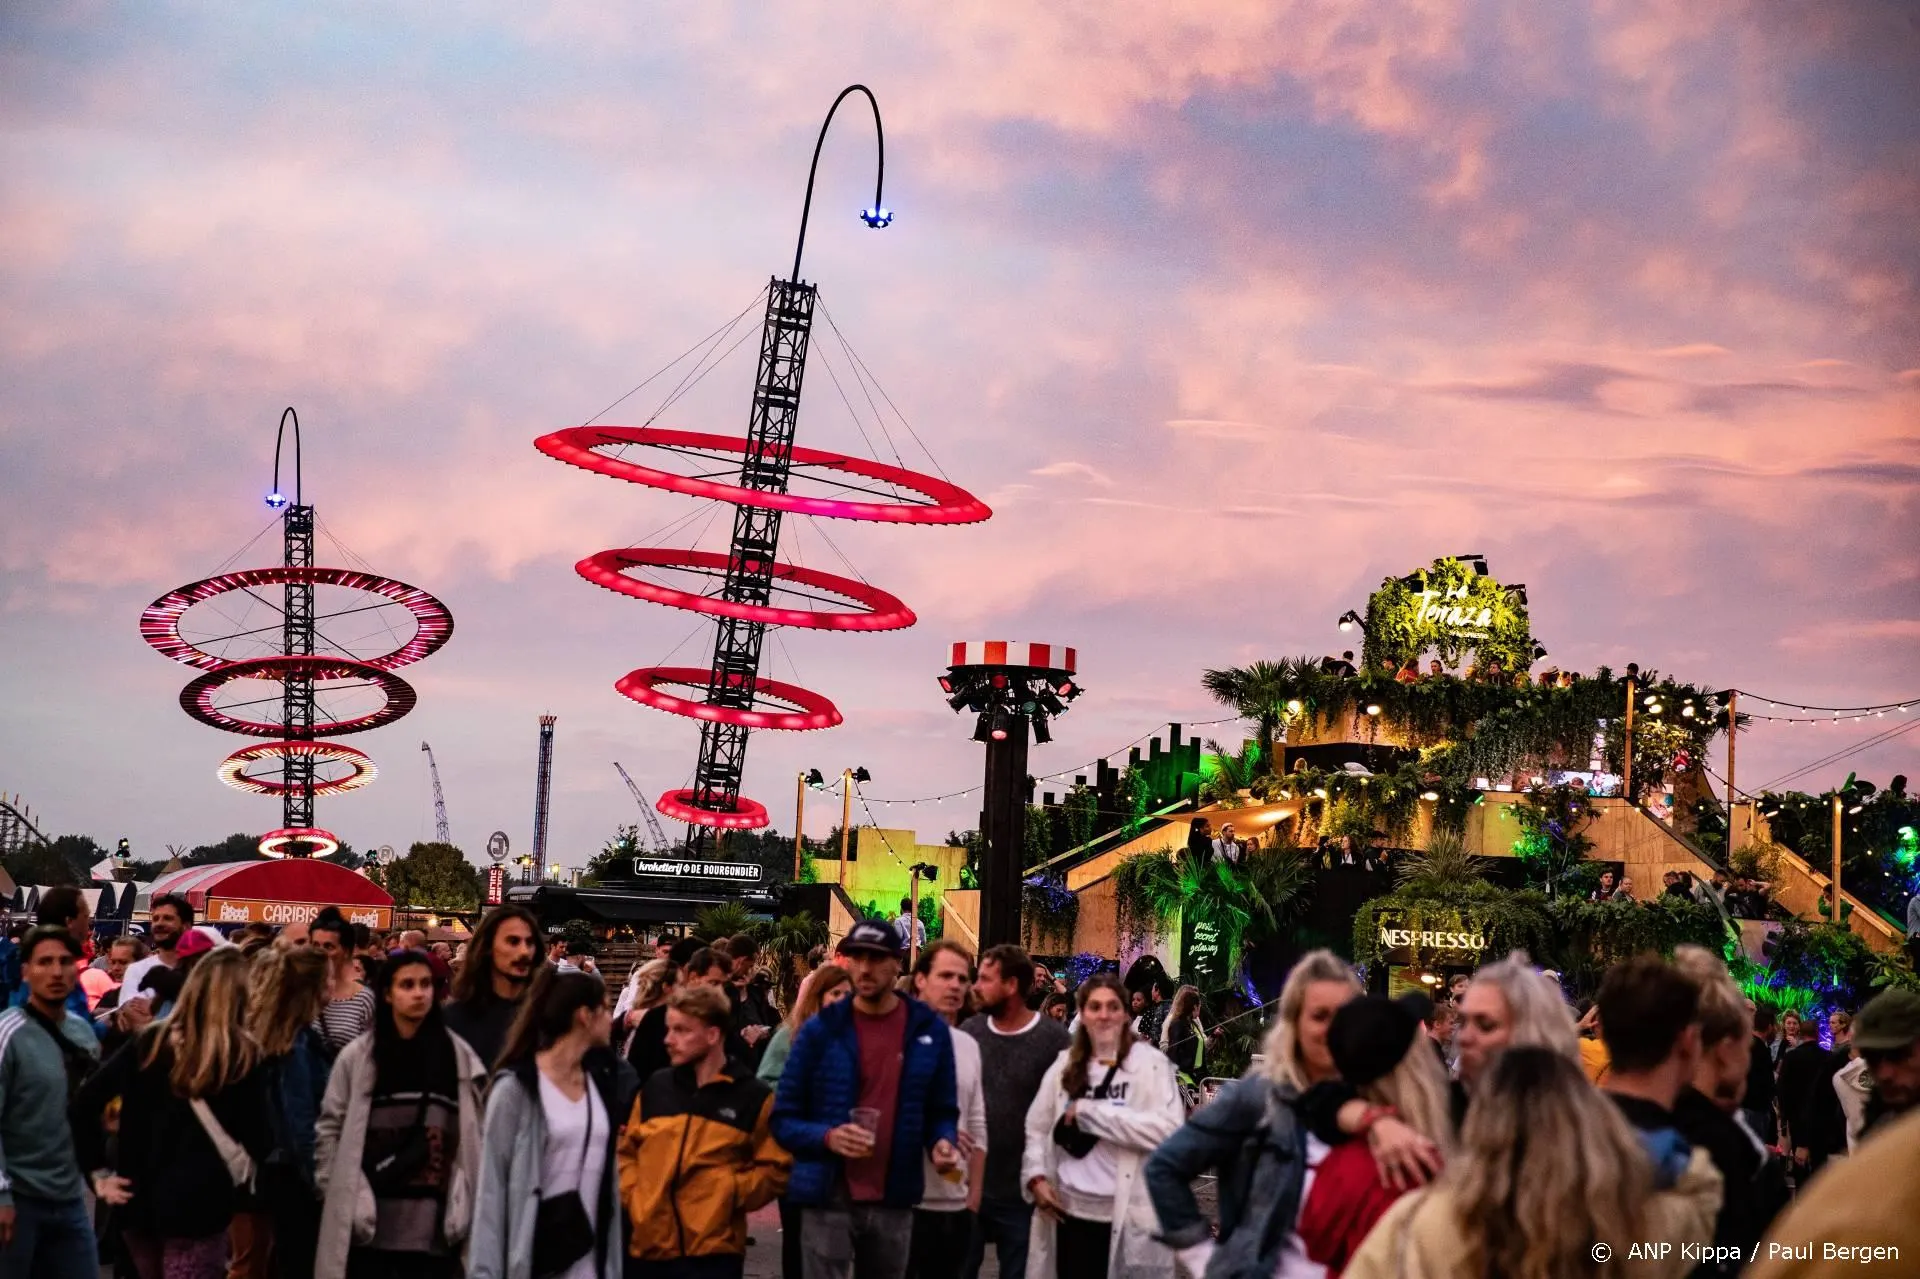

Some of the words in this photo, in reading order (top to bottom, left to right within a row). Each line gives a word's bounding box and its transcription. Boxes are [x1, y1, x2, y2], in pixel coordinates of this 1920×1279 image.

[1414, 589, 1492, 628] Terraza
[690, 865, 701, 874] DE
[262, 904, 319, 923] CARIBIS
[1194, 932, 1219, 942] secret
[1188, 942, 1218, 956] getaway
